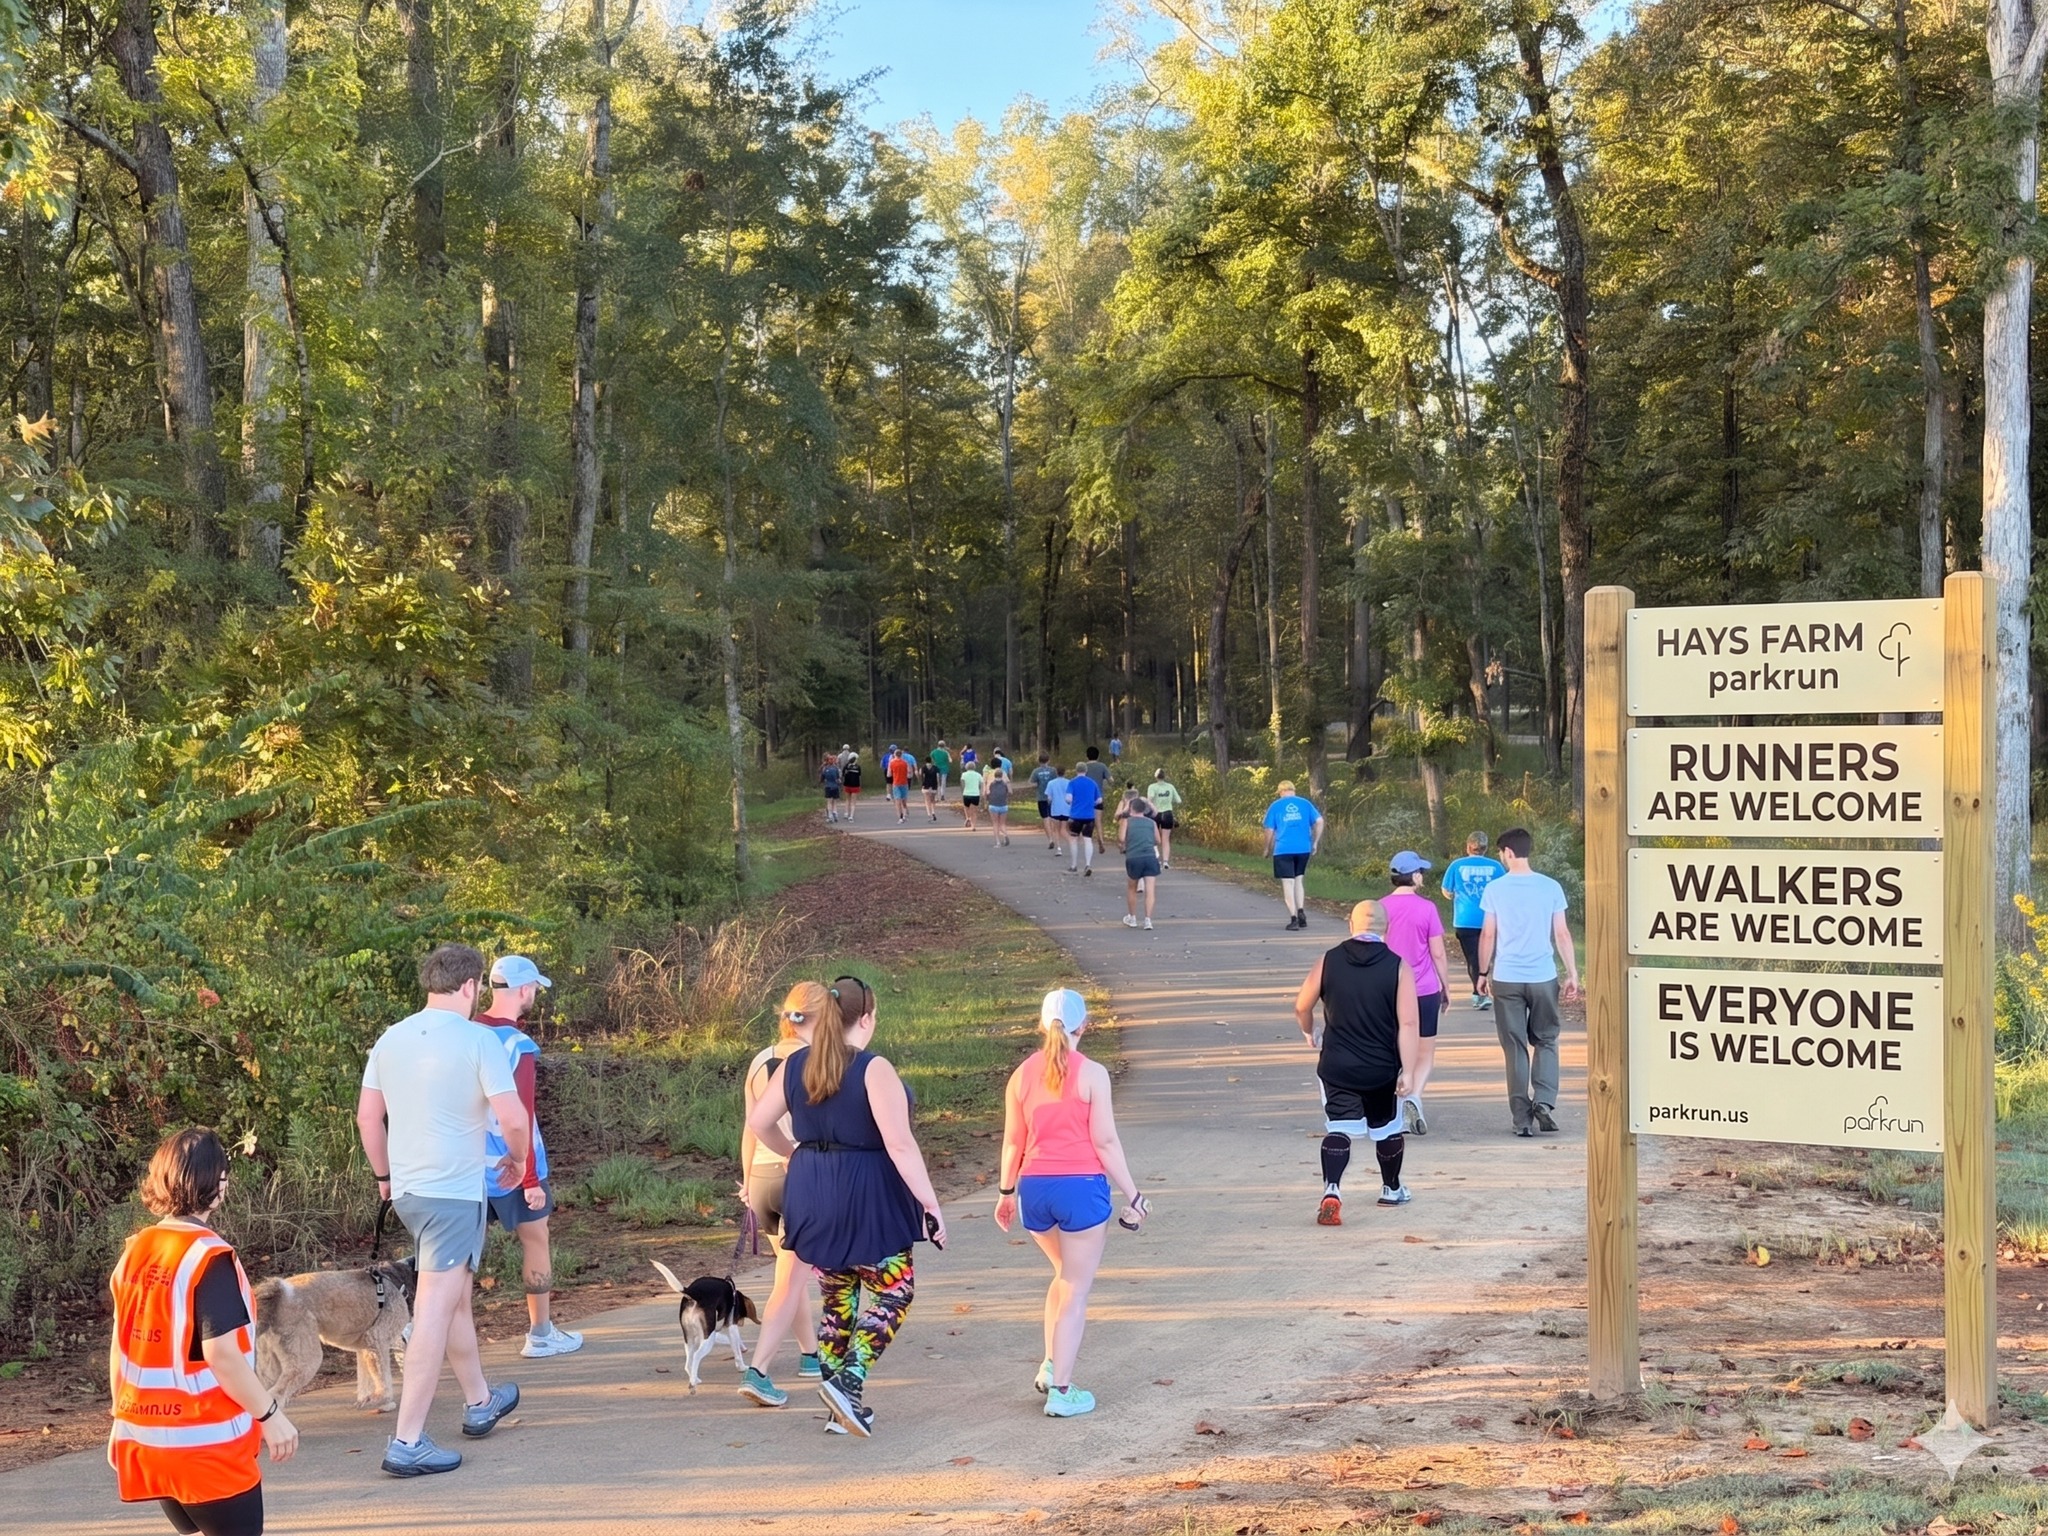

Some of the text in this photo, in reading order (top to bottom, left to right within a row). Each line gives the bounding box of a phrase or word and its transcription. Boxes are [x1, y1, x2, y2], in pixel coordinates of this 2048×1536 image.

[1658, 623, 1862, 656] HAYS FARM
[1709, 663, 1838, 698] parkrun
[1671, 742, 1899, 781] RUNNERS
[1648, 792, 1921, 821] ARE WELCOME
[1667, 864, 1902, 906] WALKERS
[1649, 912, 1922, 947] ARE WELCOME
[1659, 984, 1913, 1031] EVERYONE
[1671, 1031, 1901, 1071] IS WELCOME
[1650, 1104, 1748, 1123] parkrun.us
[1844, 1104, 1923, 1133] parkrun
